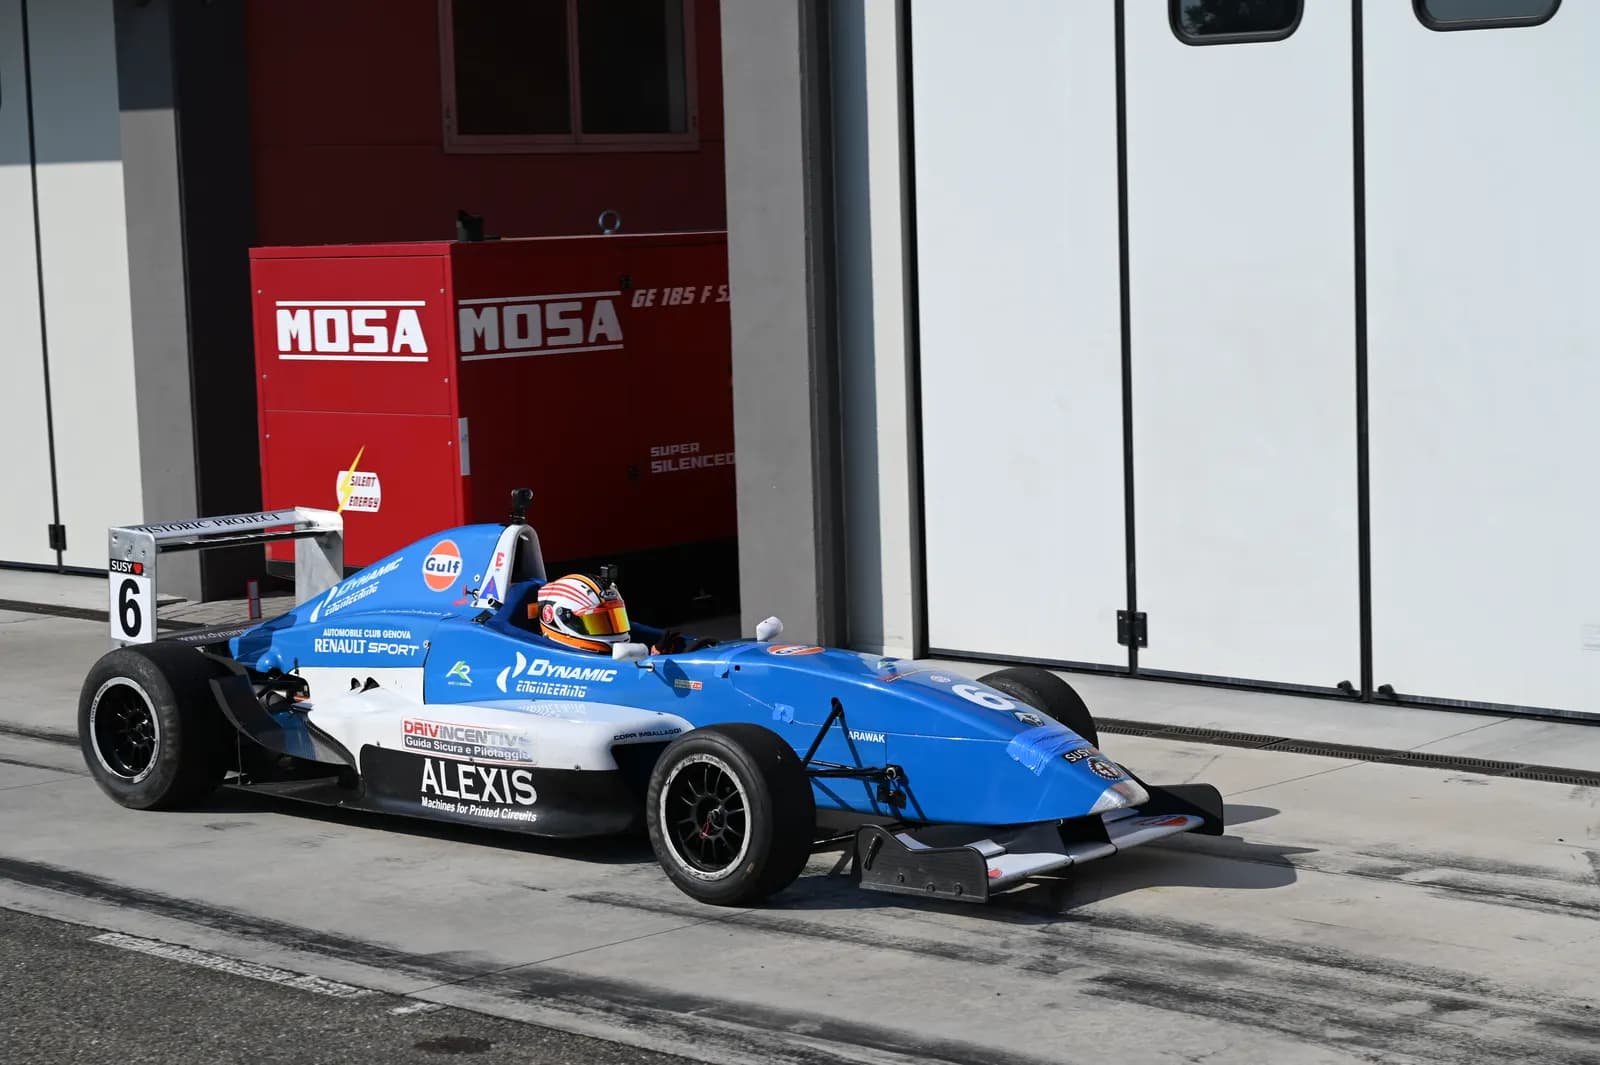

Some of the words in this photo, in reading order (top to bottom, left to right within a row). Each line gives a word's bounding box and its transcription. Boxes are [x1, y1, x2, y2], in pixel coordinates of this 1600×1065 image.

[631, 288, 658, 308] GE
[661, 286, 697, 306] 185
[700, 285, 713, 304] F
[715, 284, 730, 303] S
[276, 309, 428, 354] MOSA
[458, 300, 623, 354] MOSA
[650, 442, 700, 457] SUPER
[650, 452, 736, 474] SILENCED
[350, 475, 376, 487] SILENT
[349, 496, 378, 508] ENERGY
[213, 513, 281, 527] PROJECT
[111, 560, 133, 573] SUSY
[425, 556, 461, 574] Gulf
[119, 578, 142, 637] 6
[323, 627, 363, 638] AUTOMOBILE
[363, 629, 382, 639] CLUB
[382, 629, 412, 640] GENOVA
[314, 638, 367, 654] RENAULT
[367, 642, 420, 656] SPORT
[527, 658, 618, 683] DYNAMIC
[951, 684, 1016, 711] 6
[848, 730, 886, 744] ARAWAK
[405, 736, 432, 749] Guida
[433, 740, 463, 753] Sicura
[465, 745, 472, 754] e
[474, 745, 532, 761] Pilotaggio
[421, 757, 538, 806] ALEXIS
[421, 796, 456, 812] Machines
[456, 802, 469, 814] for
[469, 804, 500, 818] Printed
[501, 807, 537, 822] Circuits
